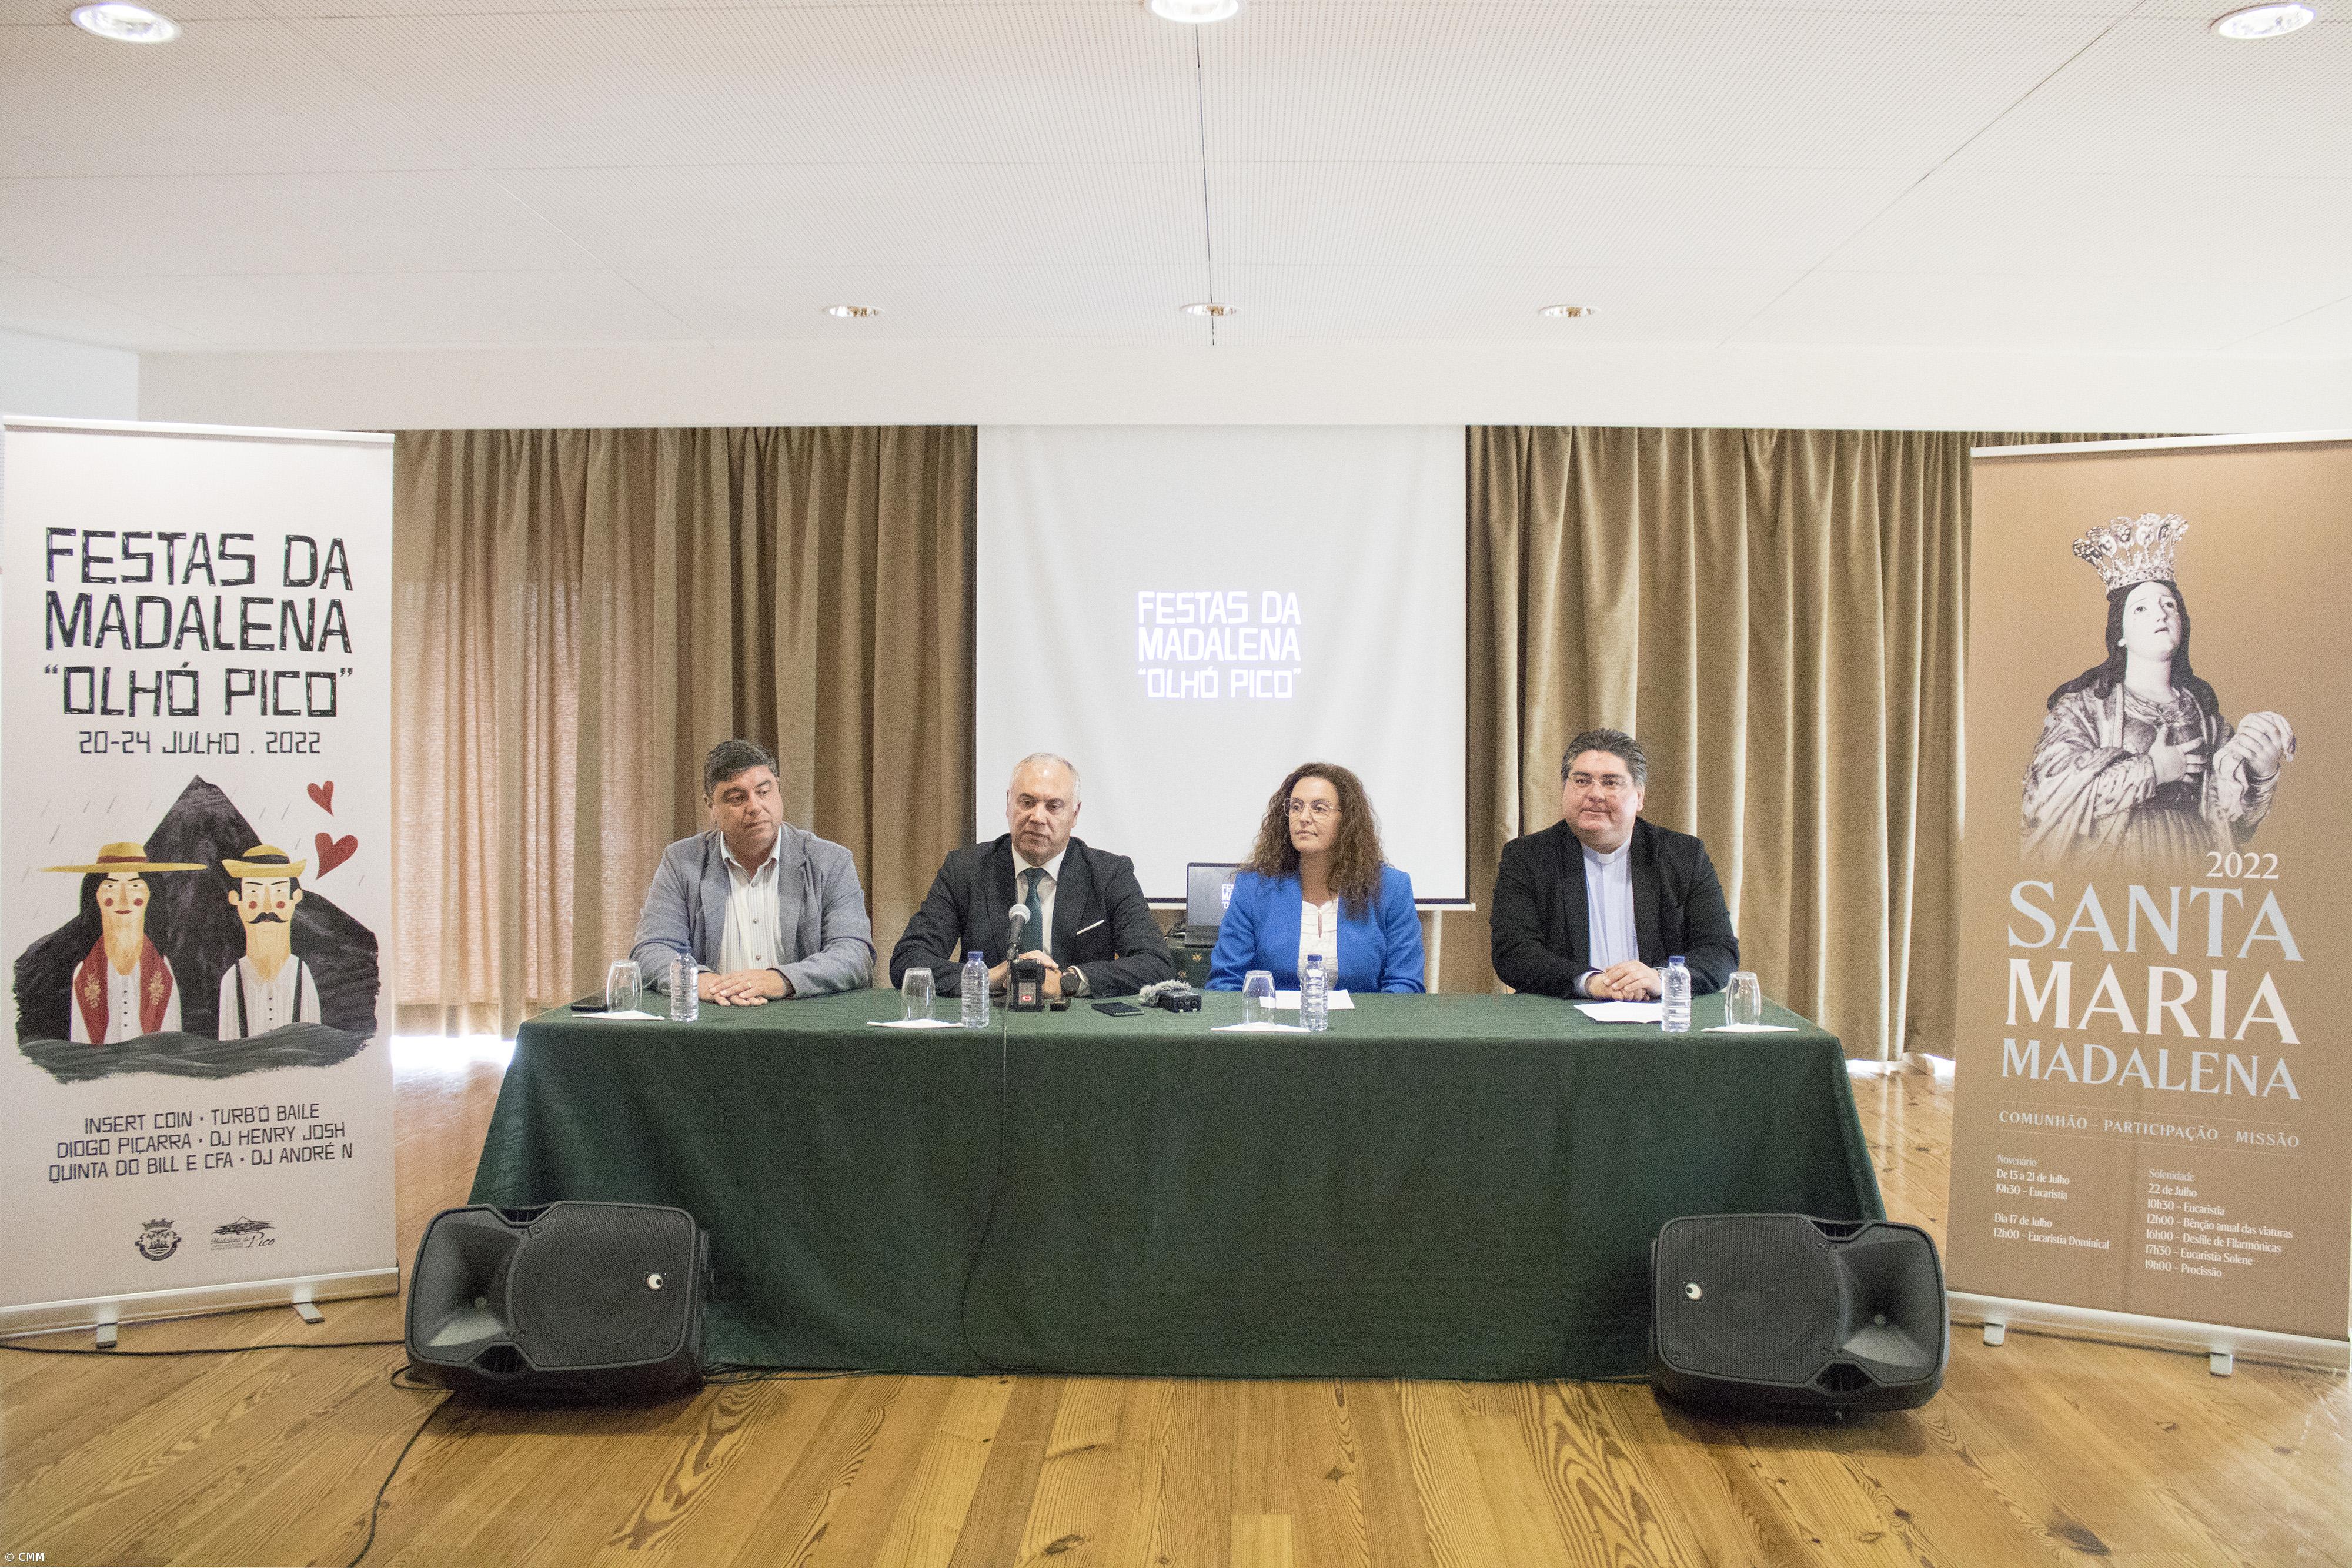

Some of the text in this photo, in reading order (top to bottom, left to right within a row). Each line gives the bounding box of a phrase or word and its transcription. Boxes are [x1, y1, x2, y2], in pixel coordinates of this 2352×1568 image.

[46, 527, 353, 591] FESTAS DA
[1138, 591, 1302, 625] FESTAS DA
[46, 590, 353, 653] MADALENA
[1138, 627, 1301, 661] MADALENA
[79, 731, 151, 754] 20-24
[162, 731, 239, 754] JULHO
[266, 731, 320, 754] 2022
[2206, 851, 2280, 880] 2022
[2008, 880, 2304, 962] SANTA
[2005, 958, 2300, 1044] MARIA
[2002, 1038, 2301, 1100] MADALENA
[85, 1115, 146, 1134] INSERT
[154, 1111, 192, 1129] COIN
[277, 1103, 319, 1121] BAILE
[1999, 1110, 2088, 1130] COMUNHÃO
[2104, 1119, 2219, 1142] PARTICIPAÇÃO
[2236, 1130, 2299, 1148] MISSÃO
[57, 1138, 110, 1159] DIOGO
[118, 1133, 192, 1155] PIÇARRA
[210, 1131, 231, 1147] DJ
[239, 1126, 295, 1146] HENRY
[303, 1122, 346, 1141] JOSH
[49, 1162, 108, 1184] QUINTA
[116, 1159, 139, 1176] DO
[147, 1156, 179, 1174] BILL
[186, 1155, 197, 1171] E
[205, 1152, 233, 1169] CFA
[252, 1149, 272, 1165] DJ
[279, 1142, 335, 1164] ANDRÉ
[342, 1142, 353, 1159] N
[1997, 1154, 2037, 1167] Novenário
[1997, 1169, 2008, 1179] De
[2026, 1171, 2035, 1182] 21
[2037, 1173, 2047, 1183] de
[2049, 1174, 2070, 1185] Julho
[2149, 1168, 2194, 1182] Solenidade
[1996, 1183, 2021, 1195] 19h30
[2029, 1186, 2068, 1200] Eucaristia
[2148, 1183, 2197, 1198] 22 de Julho
[1994, 1212, 2052, 1228] Dia 17 de Julho
[2147, 1198, 2174, 1211] 10h30
[2184, 1202, 2224, 1216] Eucaristia
[1994, 1227, 2020, 1239] 12h00
[2028, 1231, 2066, 1245] Eucaristia
[2069, 1235, 2110, 1249] Dominical
[2147, 1213, 2174, 1226] 12h00
[2183, 1217, 2214, 1231] Bênção
[2216, 1222, 2239, 1233] anual
[2241, 1223, 2257, 1234] das
[2259, 1226, 2293, 1239] viaturas
[2146, 1229, 2174, 1241] 16h00
[2183, 1232, 2211, 1245] Desfile
[2213, 1236, 2224, 1246] de
[2226, 1237, 2281, 1253] Filarmónicas
[2146, 1244, 2171, 1256] 17h30
[2181, 1248, 2221, 1262] Eucaristia
[2223, 1252, 2253, 1265] Solene
[2145, 1259, 2172, 1271] 19h00
[2181, 1263, 2222, 1277] Procissão
